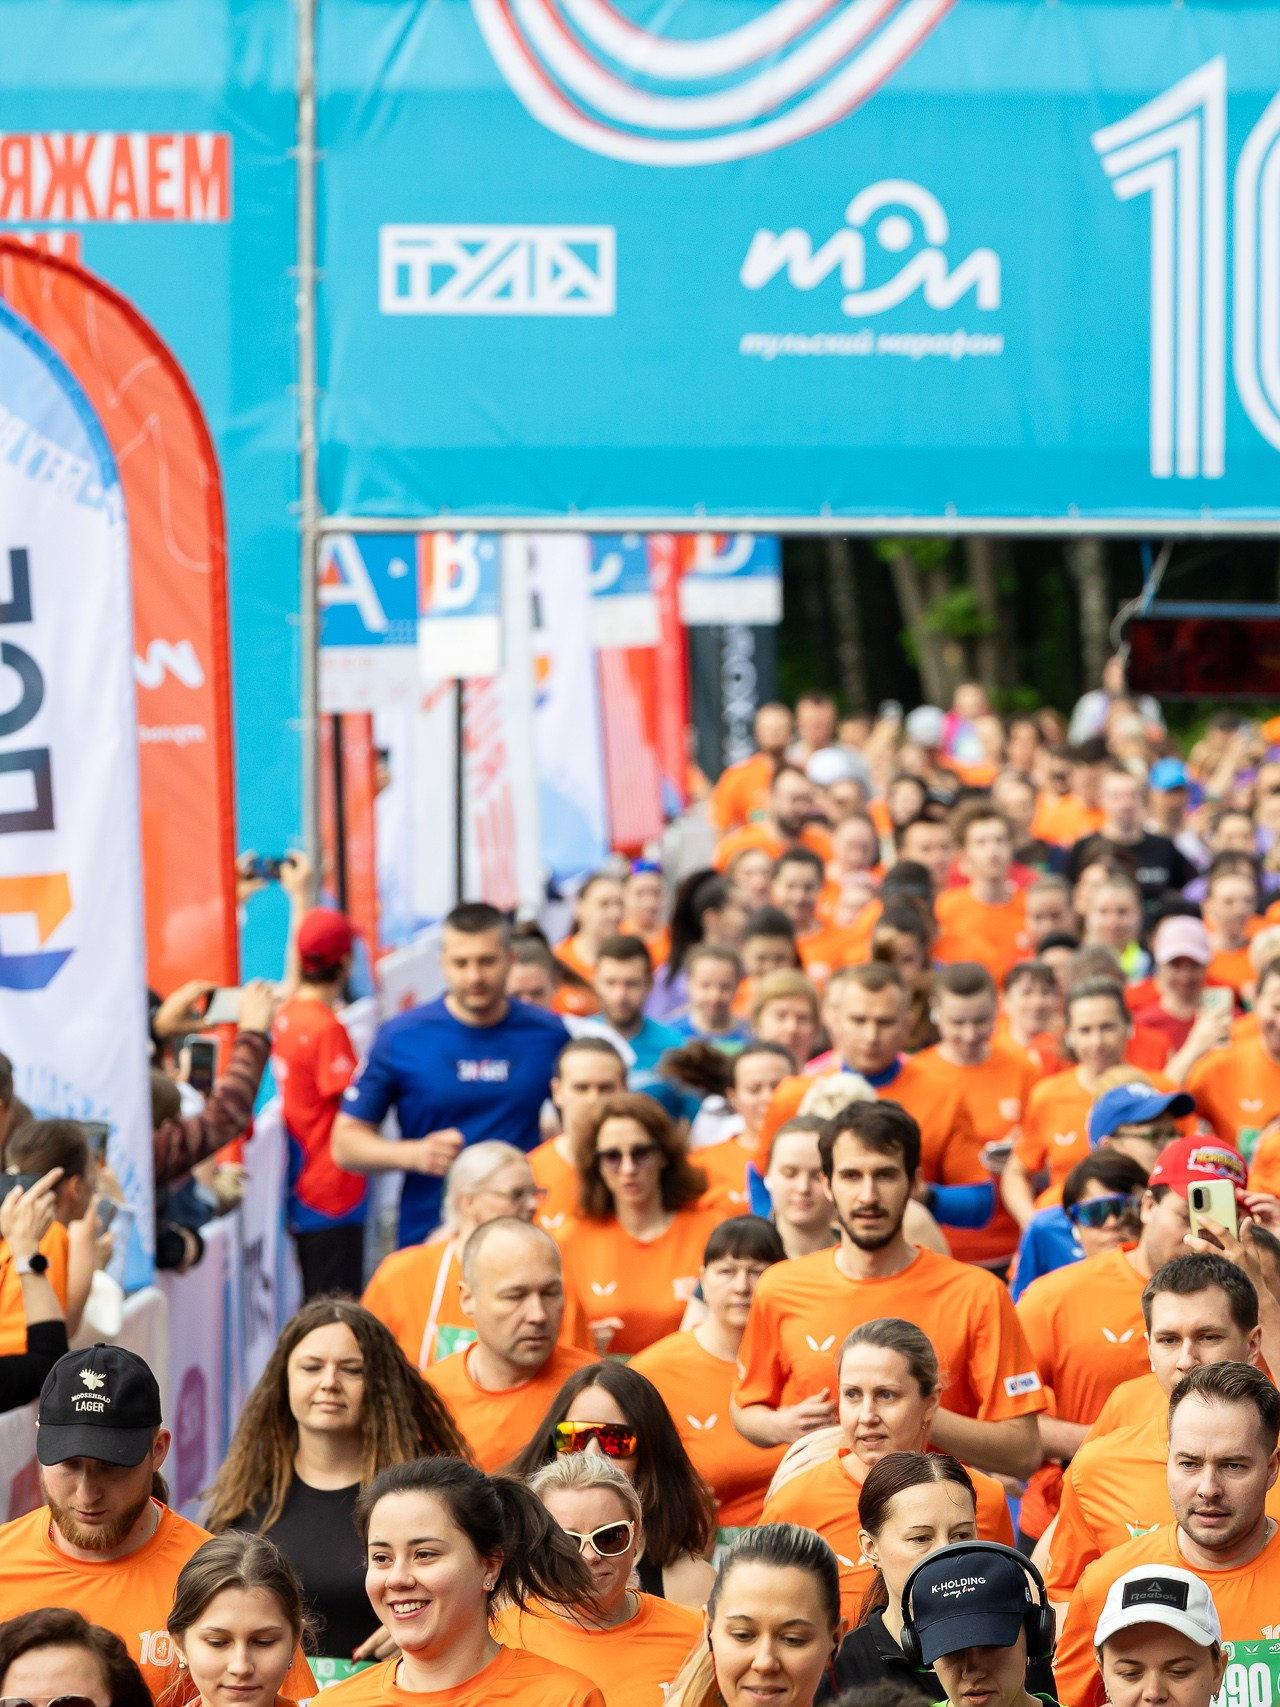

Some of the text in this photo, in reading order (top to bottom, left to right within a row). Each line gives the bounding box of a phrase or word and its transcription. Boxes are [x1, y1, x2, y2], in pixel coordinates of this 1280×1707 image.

[0, 131, 232, 224] ЯЖАЕМ
[318, 532, 388, 632] A
[71, 1392, 111, 1404] MOOSEHEAD
[75, 1400, 104, 1413] LAGER
[931, 1576, 987, 1594] K-HOLDING
[1130, 1591, 1177, 1602] Reebok
[139, 1629, 176, 1668] 10
